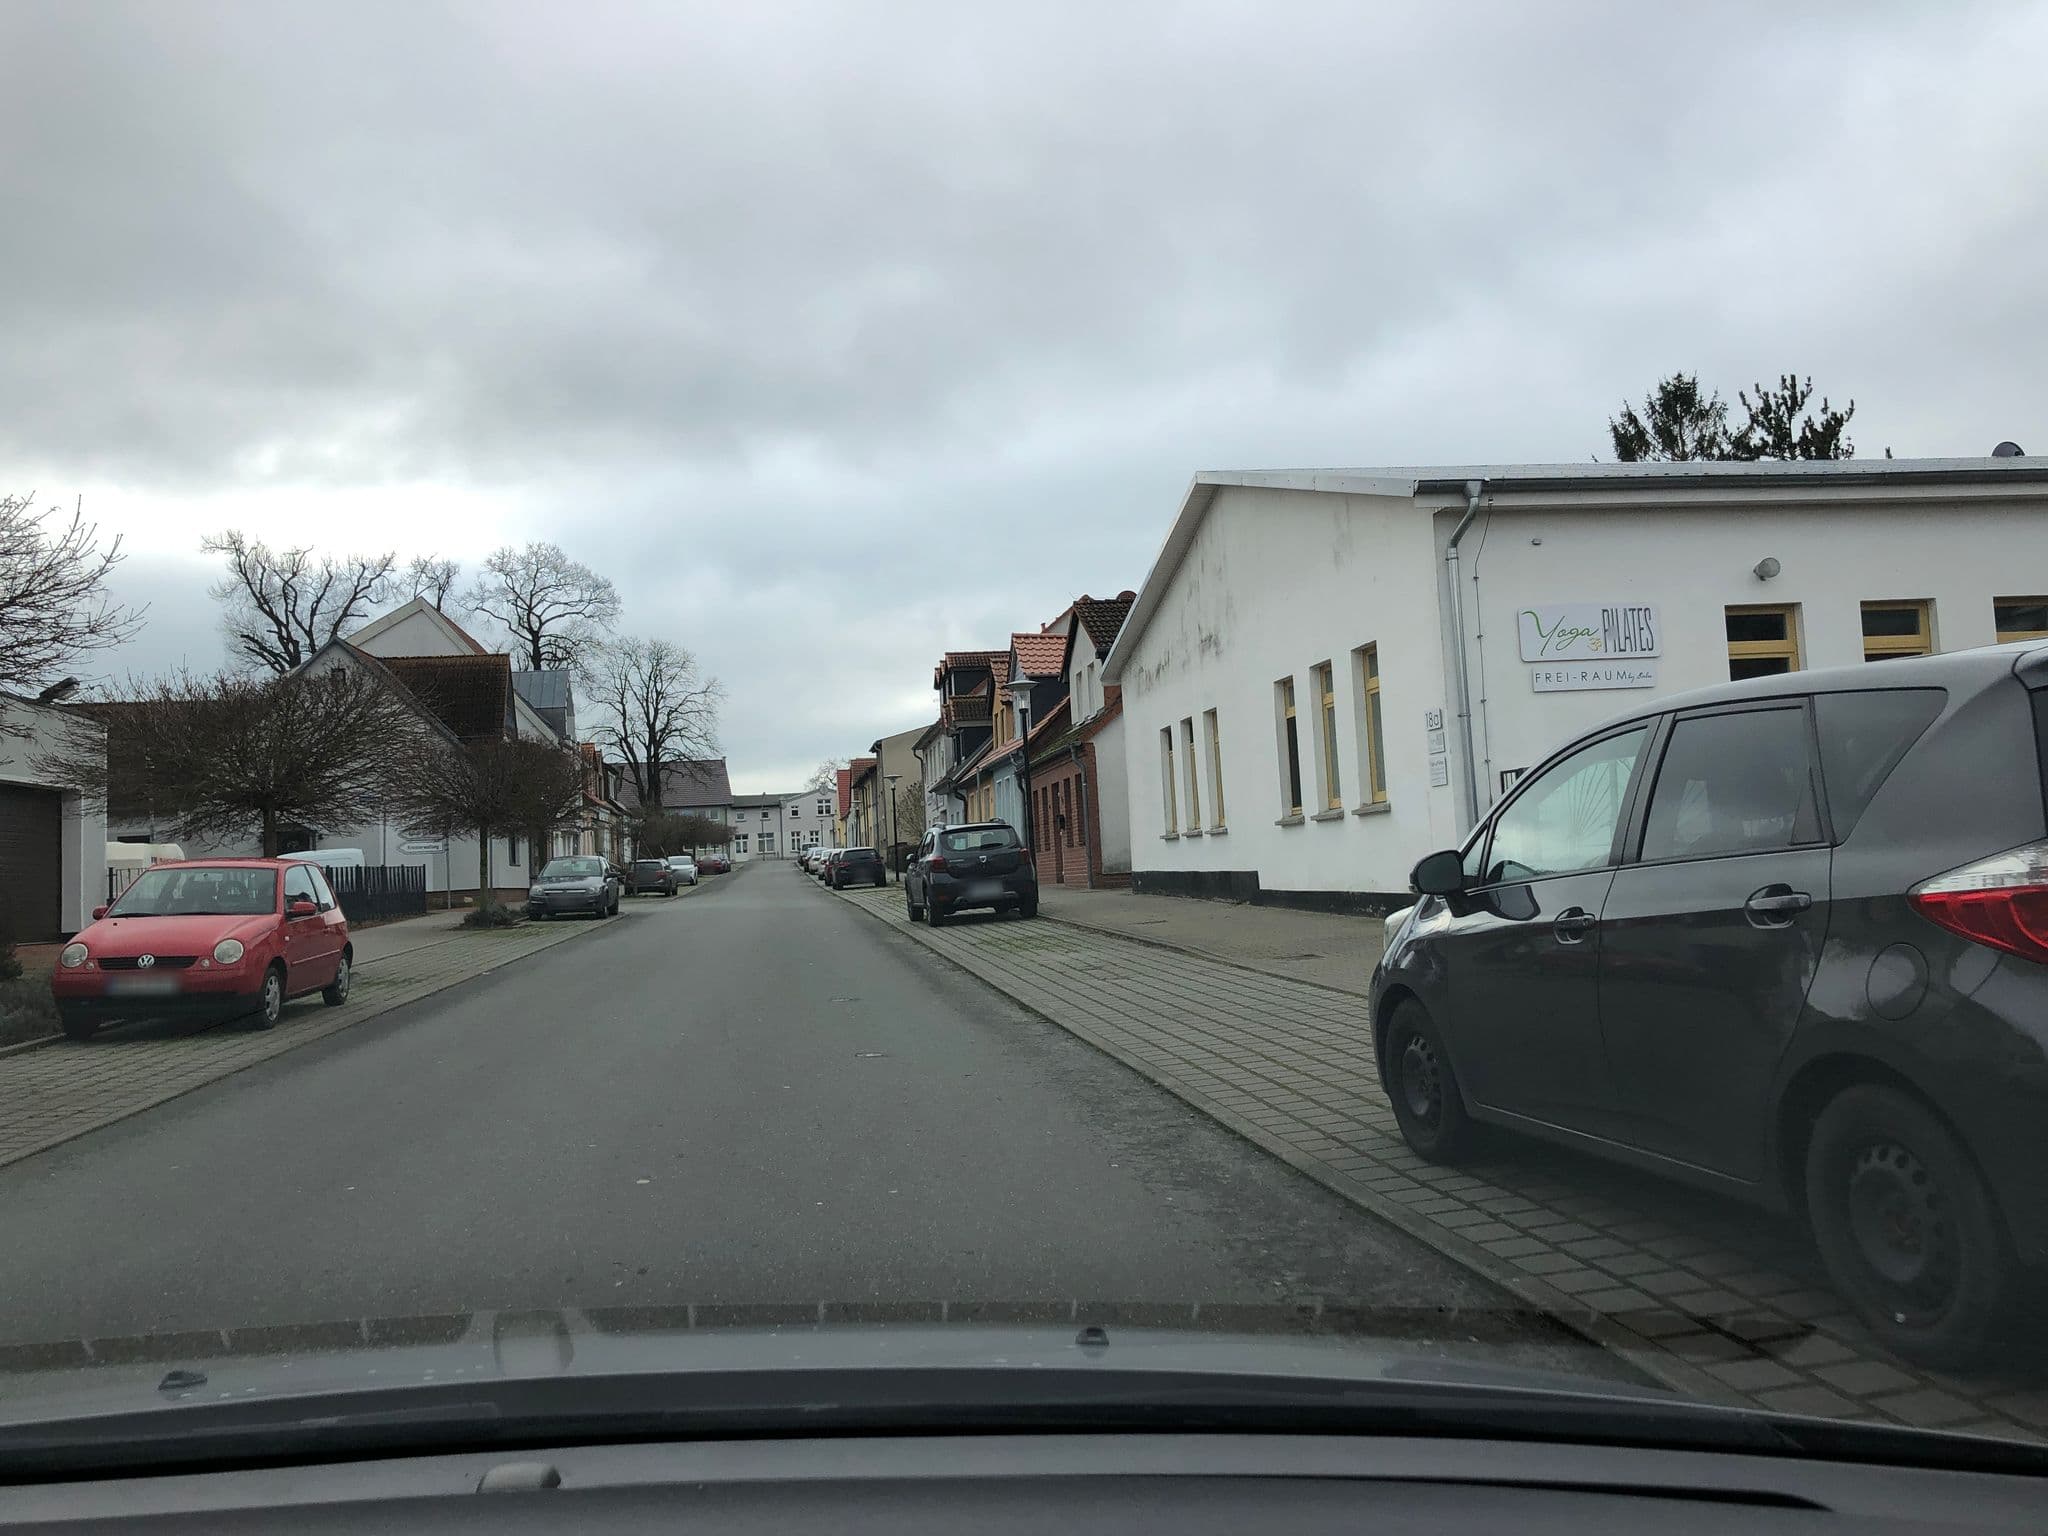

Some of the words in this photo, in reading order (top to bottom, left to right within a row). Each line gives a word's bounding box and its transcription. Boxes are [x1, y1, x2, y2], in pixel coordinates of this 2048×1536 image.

[1520, 611, 1599, 656] Yoga
[1602, 607, 1654, 653] PILATES
[1535, 670, 1627, 683] FREI-RAUM
